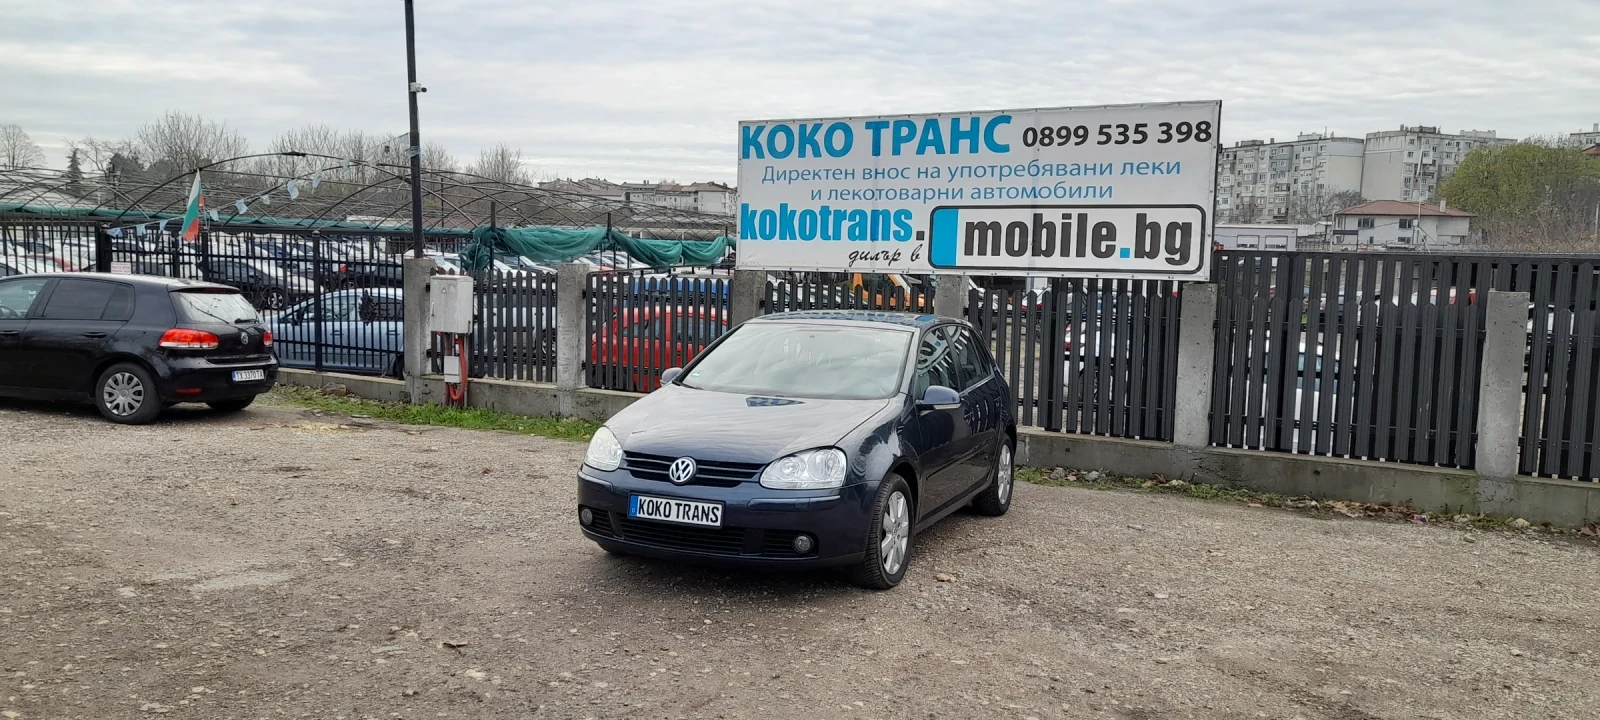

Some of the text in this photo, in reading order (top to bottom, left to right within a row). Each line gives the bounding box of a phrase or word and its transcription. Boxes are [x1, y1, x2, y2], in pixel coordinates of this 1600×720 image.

[742, 115, 1012, 159] КОКО ТРАНС
[1023, 121, 1212, 147] 0899 535 398
[762, 159, 1181, 184] Директен внос на употребявани леки
[811, 181, 1113, 204] и лекотоварни автомобили
[964, 213, 1193, 265] mobile.bg
[848, 244, 923, 267] дилър в
[638, 498, 720, 523] KOKO TRANS
